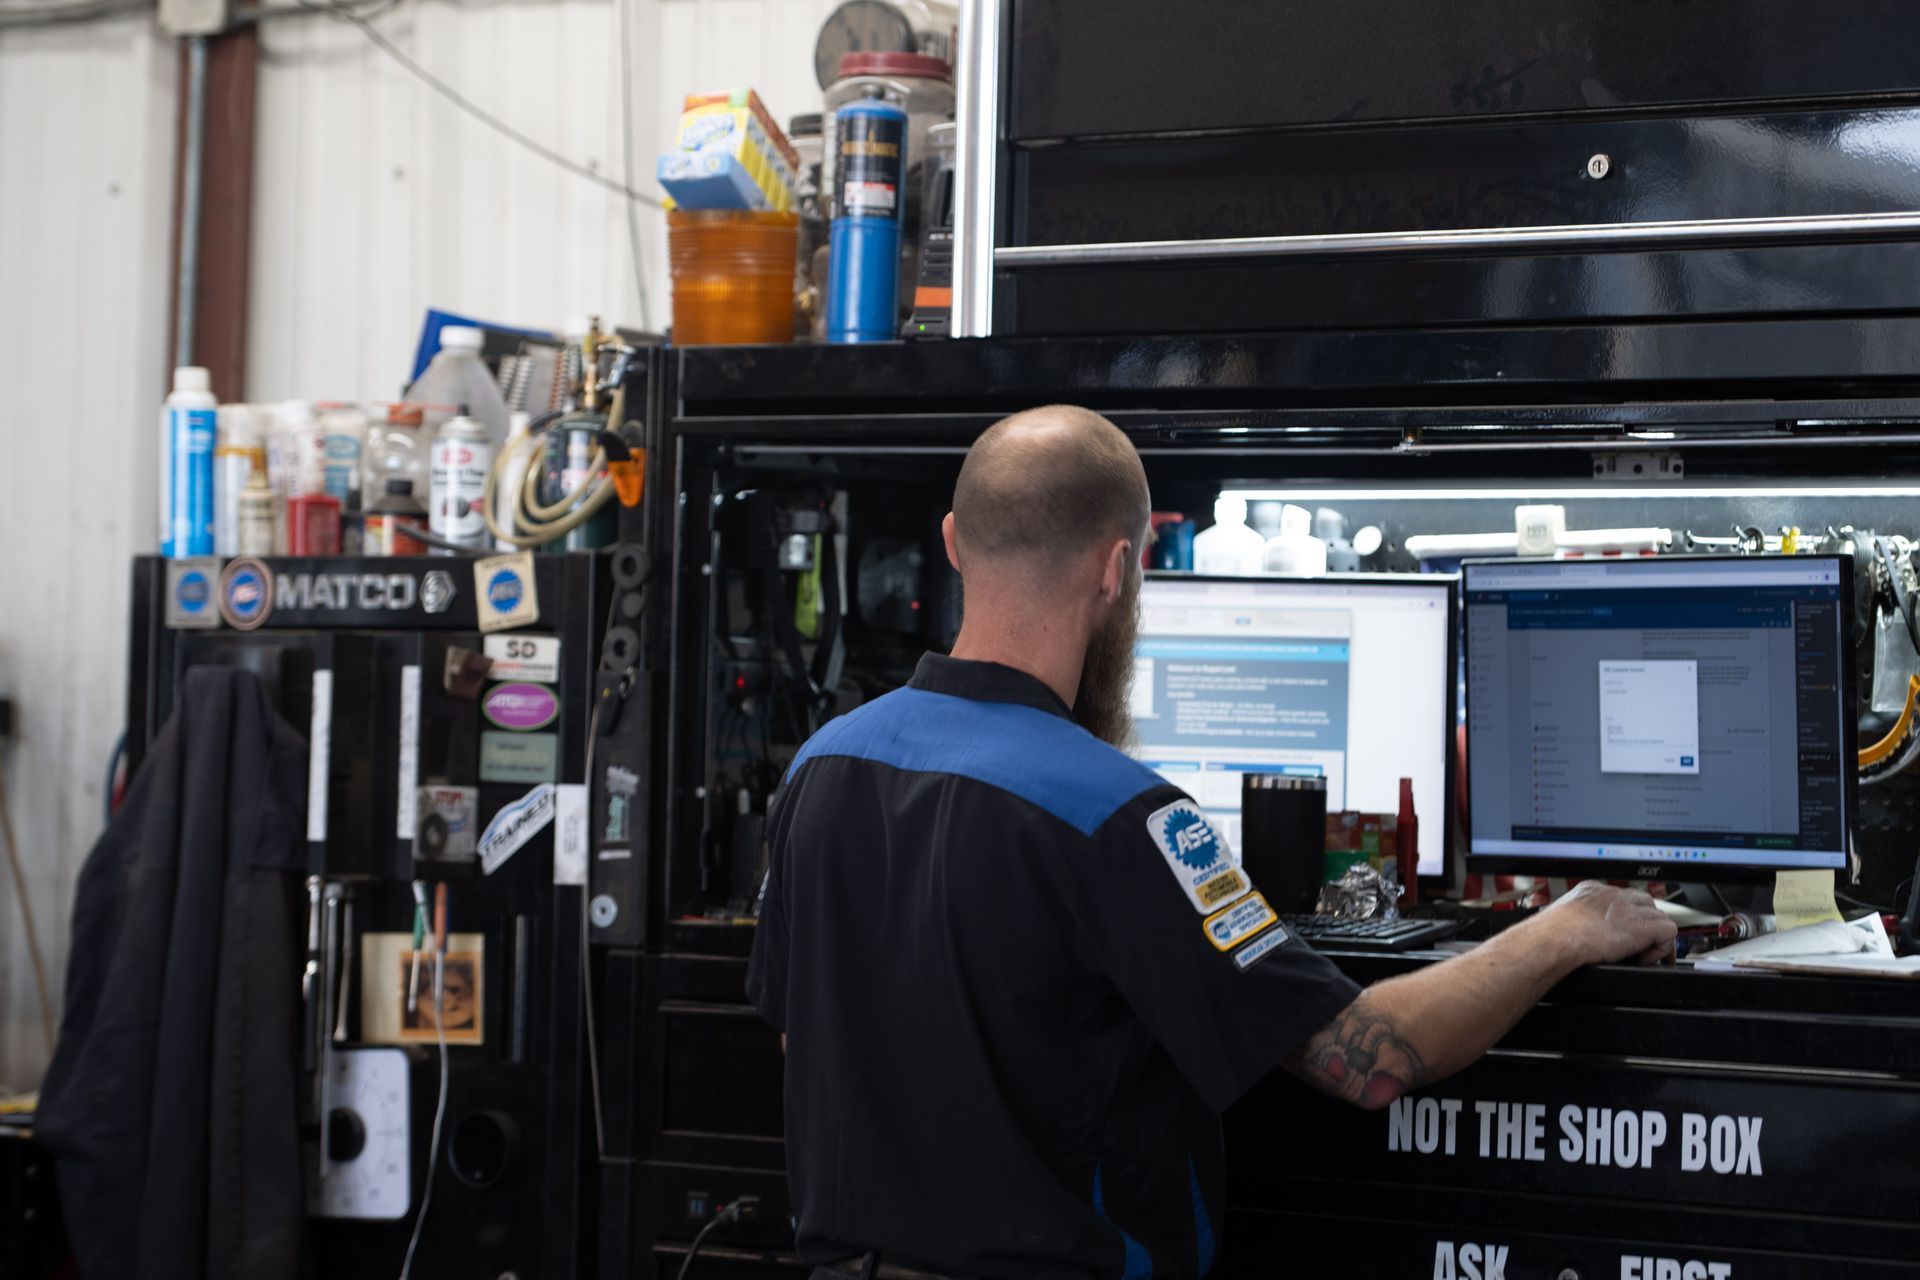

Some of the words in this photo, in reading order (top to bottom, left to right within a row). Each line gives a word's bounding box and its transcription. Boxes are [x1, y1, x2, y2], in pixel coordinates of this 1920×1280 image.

[275, 574, 416, 610] MATCO
[1176, 821, 1213, 857] ASE
[1637, 866, 1660, 877] acer
[1388, 1097, 1462, 1156] NOT
[1475, 1101, 1546, 1161] THE
[1558, 1104, 1667, 1169] SHOP
[1681, 1112, 1763, 1176] BOX
[1433, 1241, 1510, 1280] ASK
